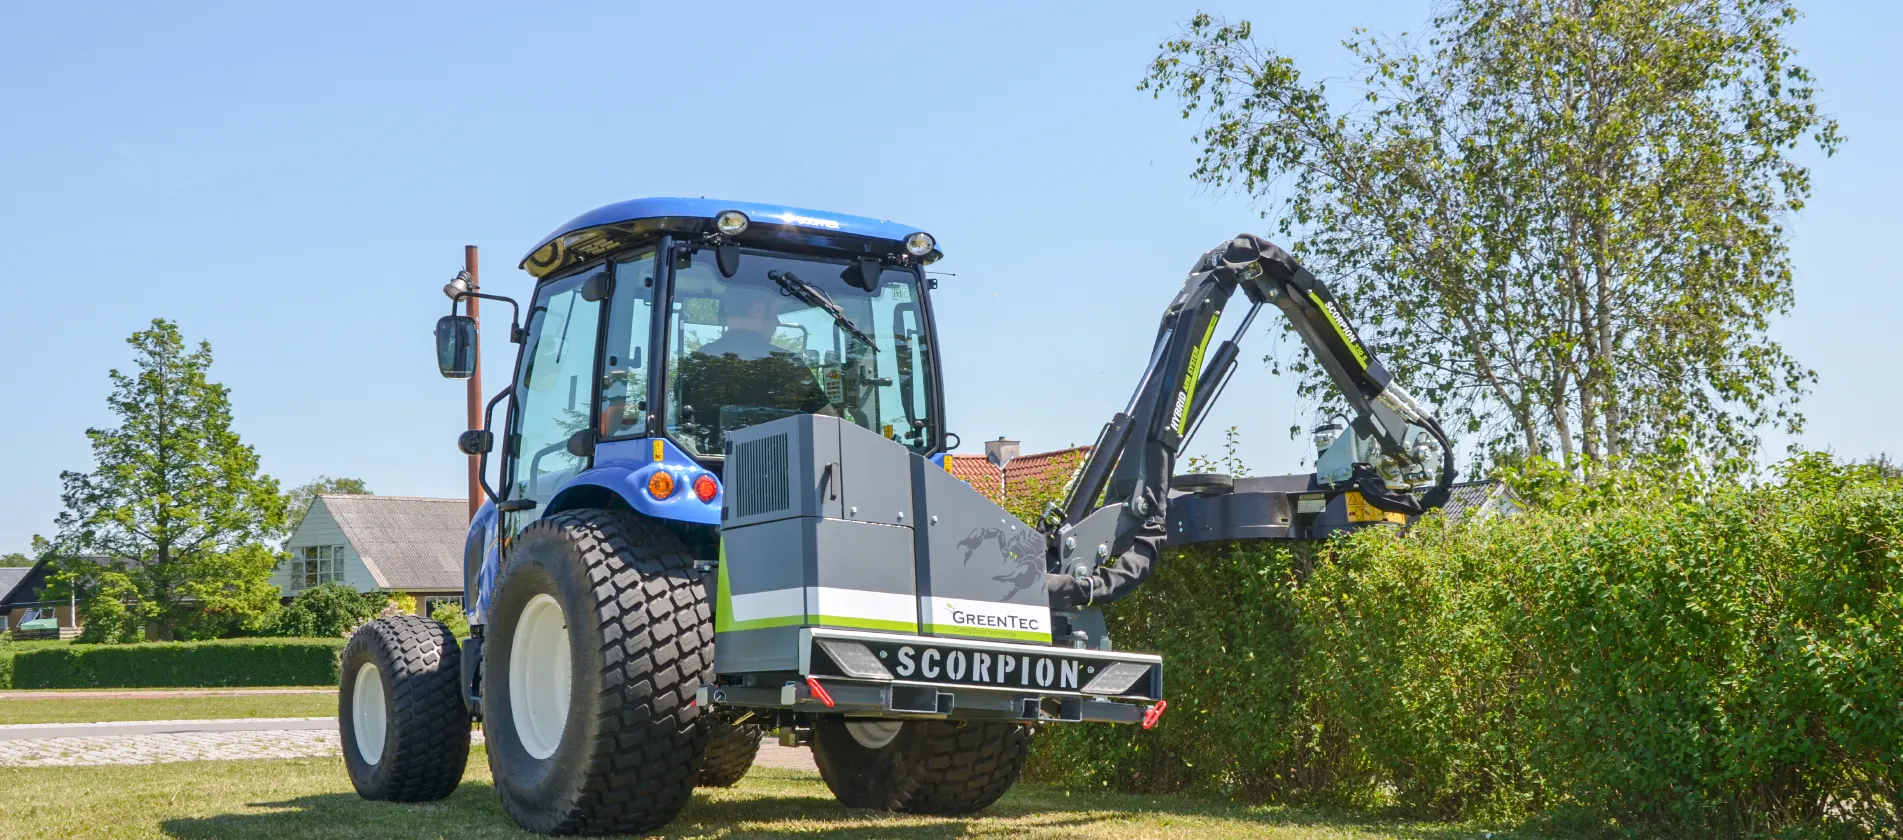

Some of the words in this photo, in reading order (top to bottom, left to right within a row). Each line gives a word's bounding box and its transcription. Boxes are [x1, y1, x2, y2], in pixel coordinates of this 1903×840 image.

[1325, 301, 1357, 342] SCORPION
[1187, 345, 1200, 376] SYSTEM
[1183, 374, 1193, 392] ARM
[1170, 391, 1187, 431] HYBRID
[896, 646, 1078, 688] SCORPION
